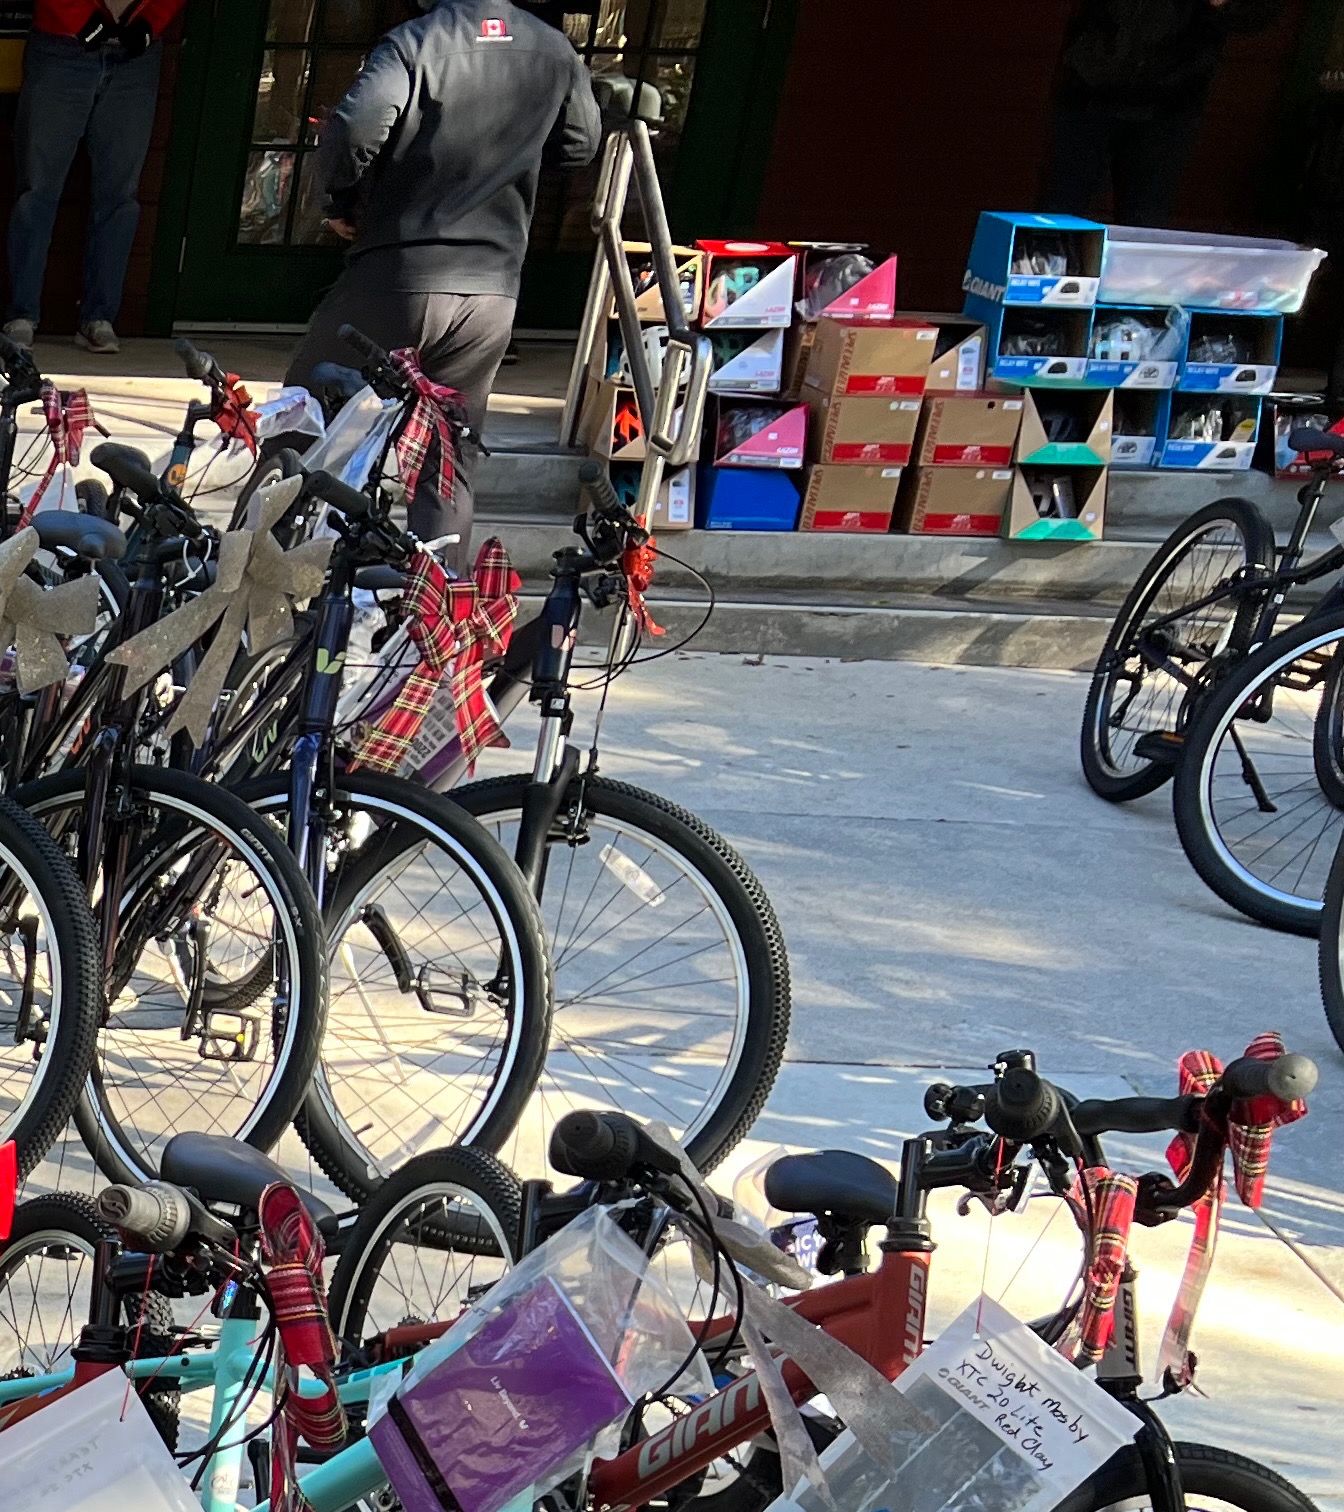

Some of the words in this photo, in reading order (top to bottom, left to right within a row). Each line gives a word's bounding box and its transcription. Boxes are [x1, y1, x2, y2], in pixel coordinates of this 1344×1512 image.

[947, 1376, 990, 1412] GIANT
[975, 1341, 1042, 1399] Dwight
[987, 1387, 1009, 1409] 20
[1010, 1404, 1044, 1439] Lite
[994, 1413, 1018, 1441] Red
[1020, 1437, 1054, 1472] Clay
